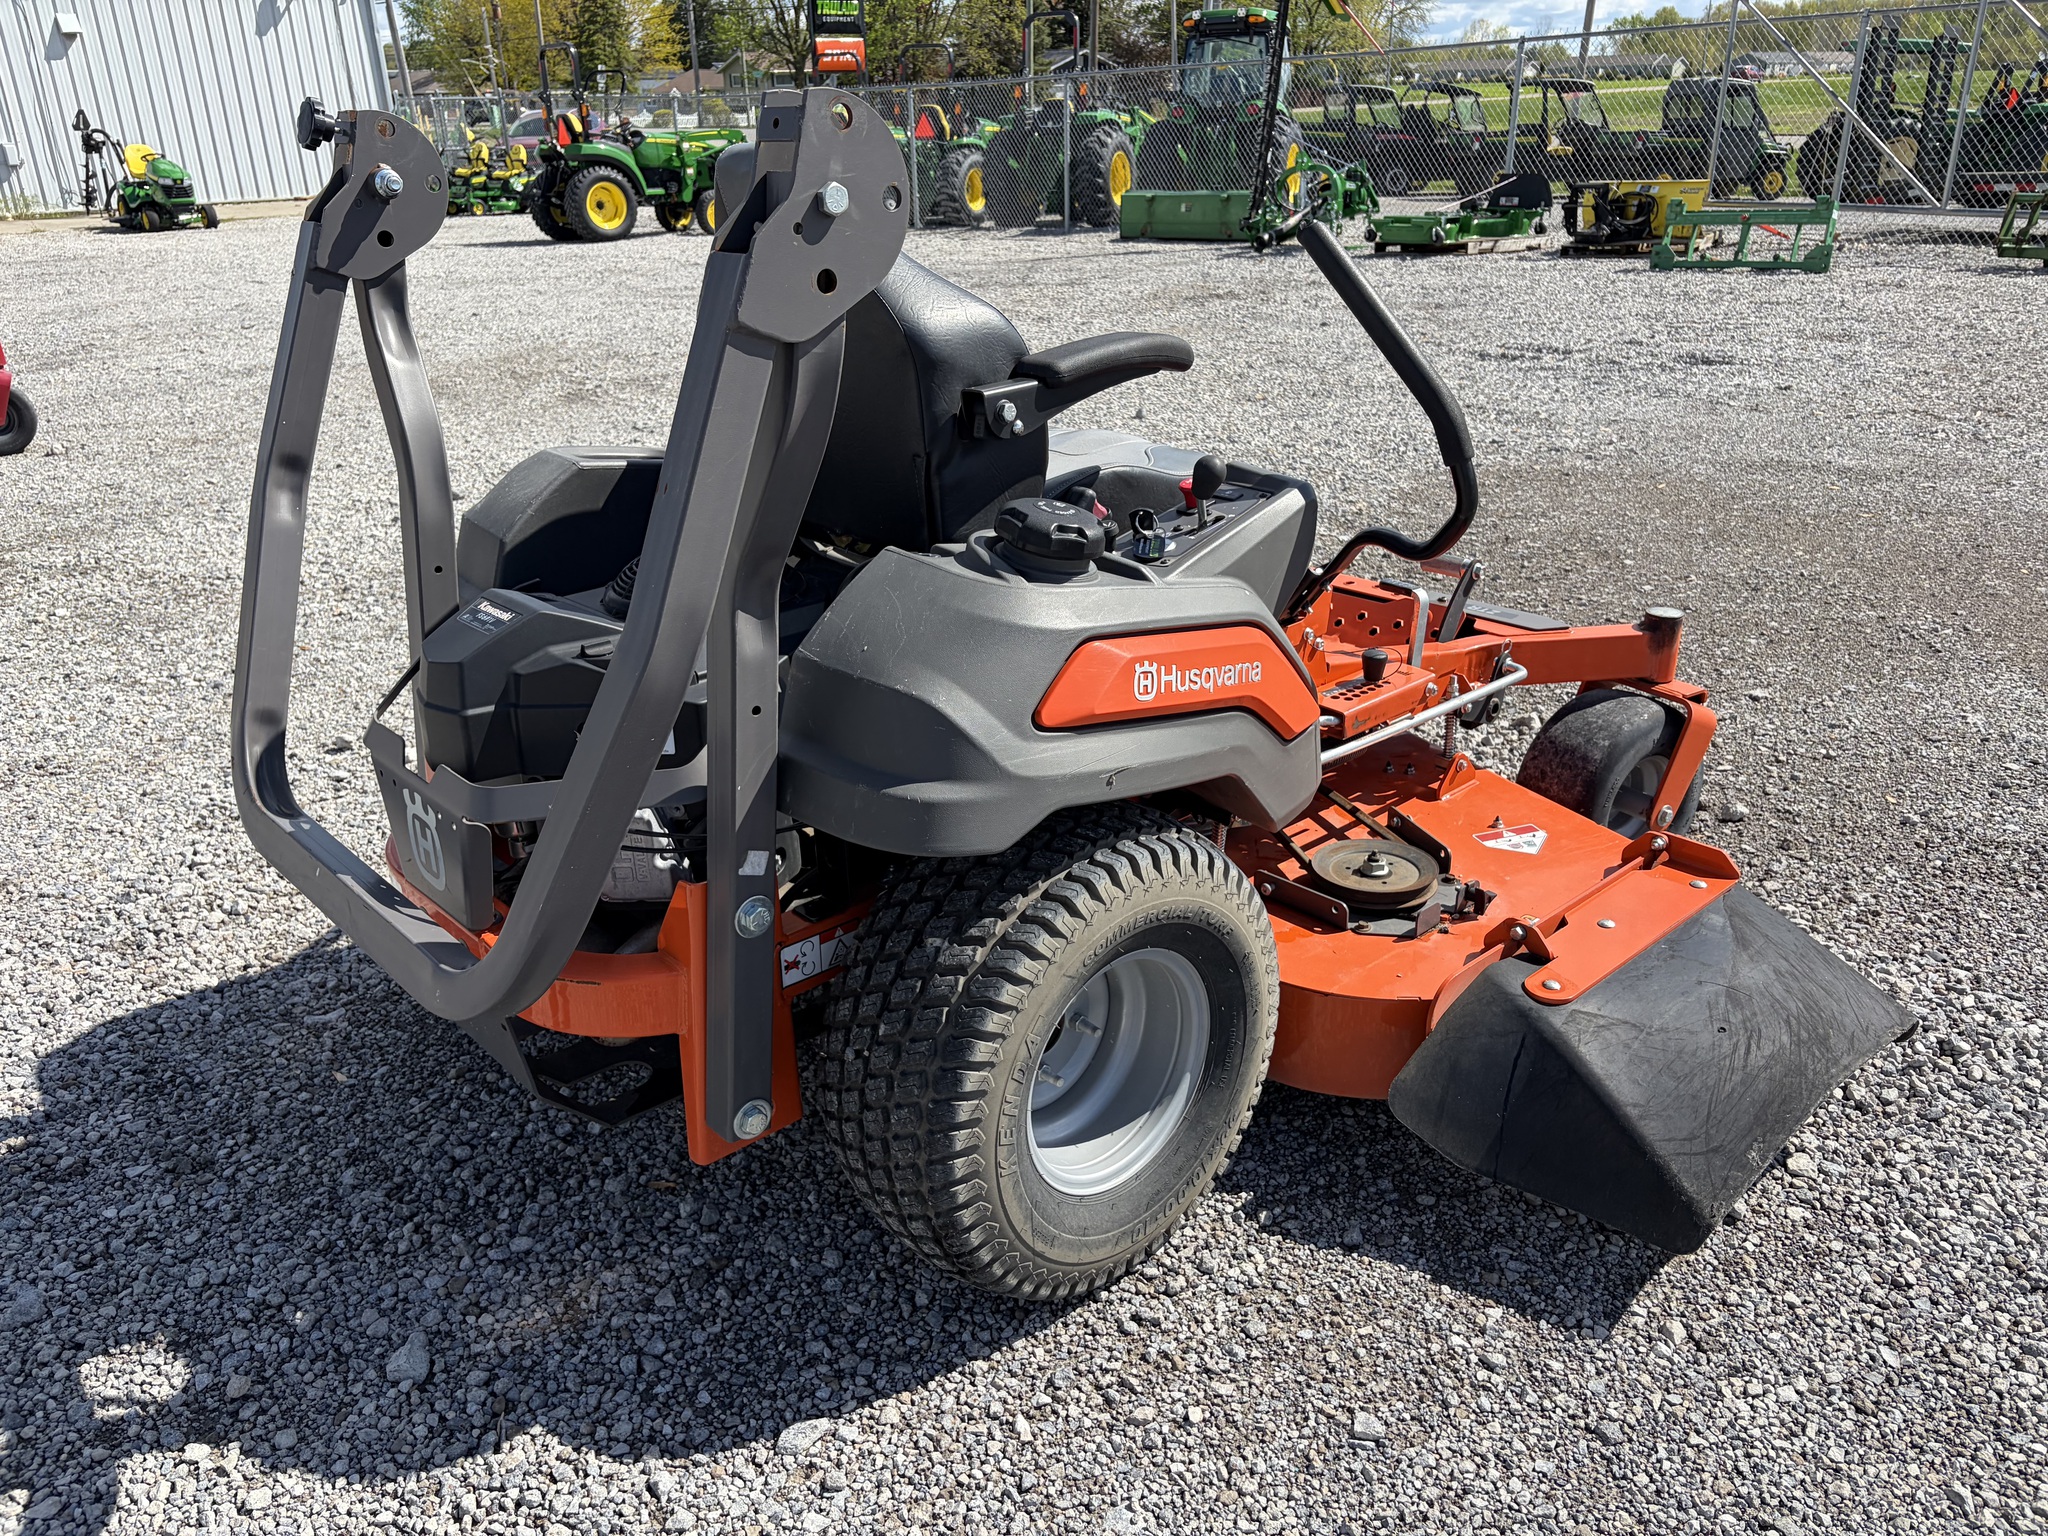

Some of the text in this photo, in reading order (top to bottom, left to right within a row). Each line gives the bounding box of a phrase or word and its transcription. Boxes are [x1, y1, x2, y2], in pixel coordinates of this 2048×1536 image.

[477, 601, 516, 621] Kawasaki
[1160, 661, 1262, 693] Husqvarna
[1083, 905, 1194, 967] COMMERCIAL
[998, 1032, 1042, 1179] KENDA
